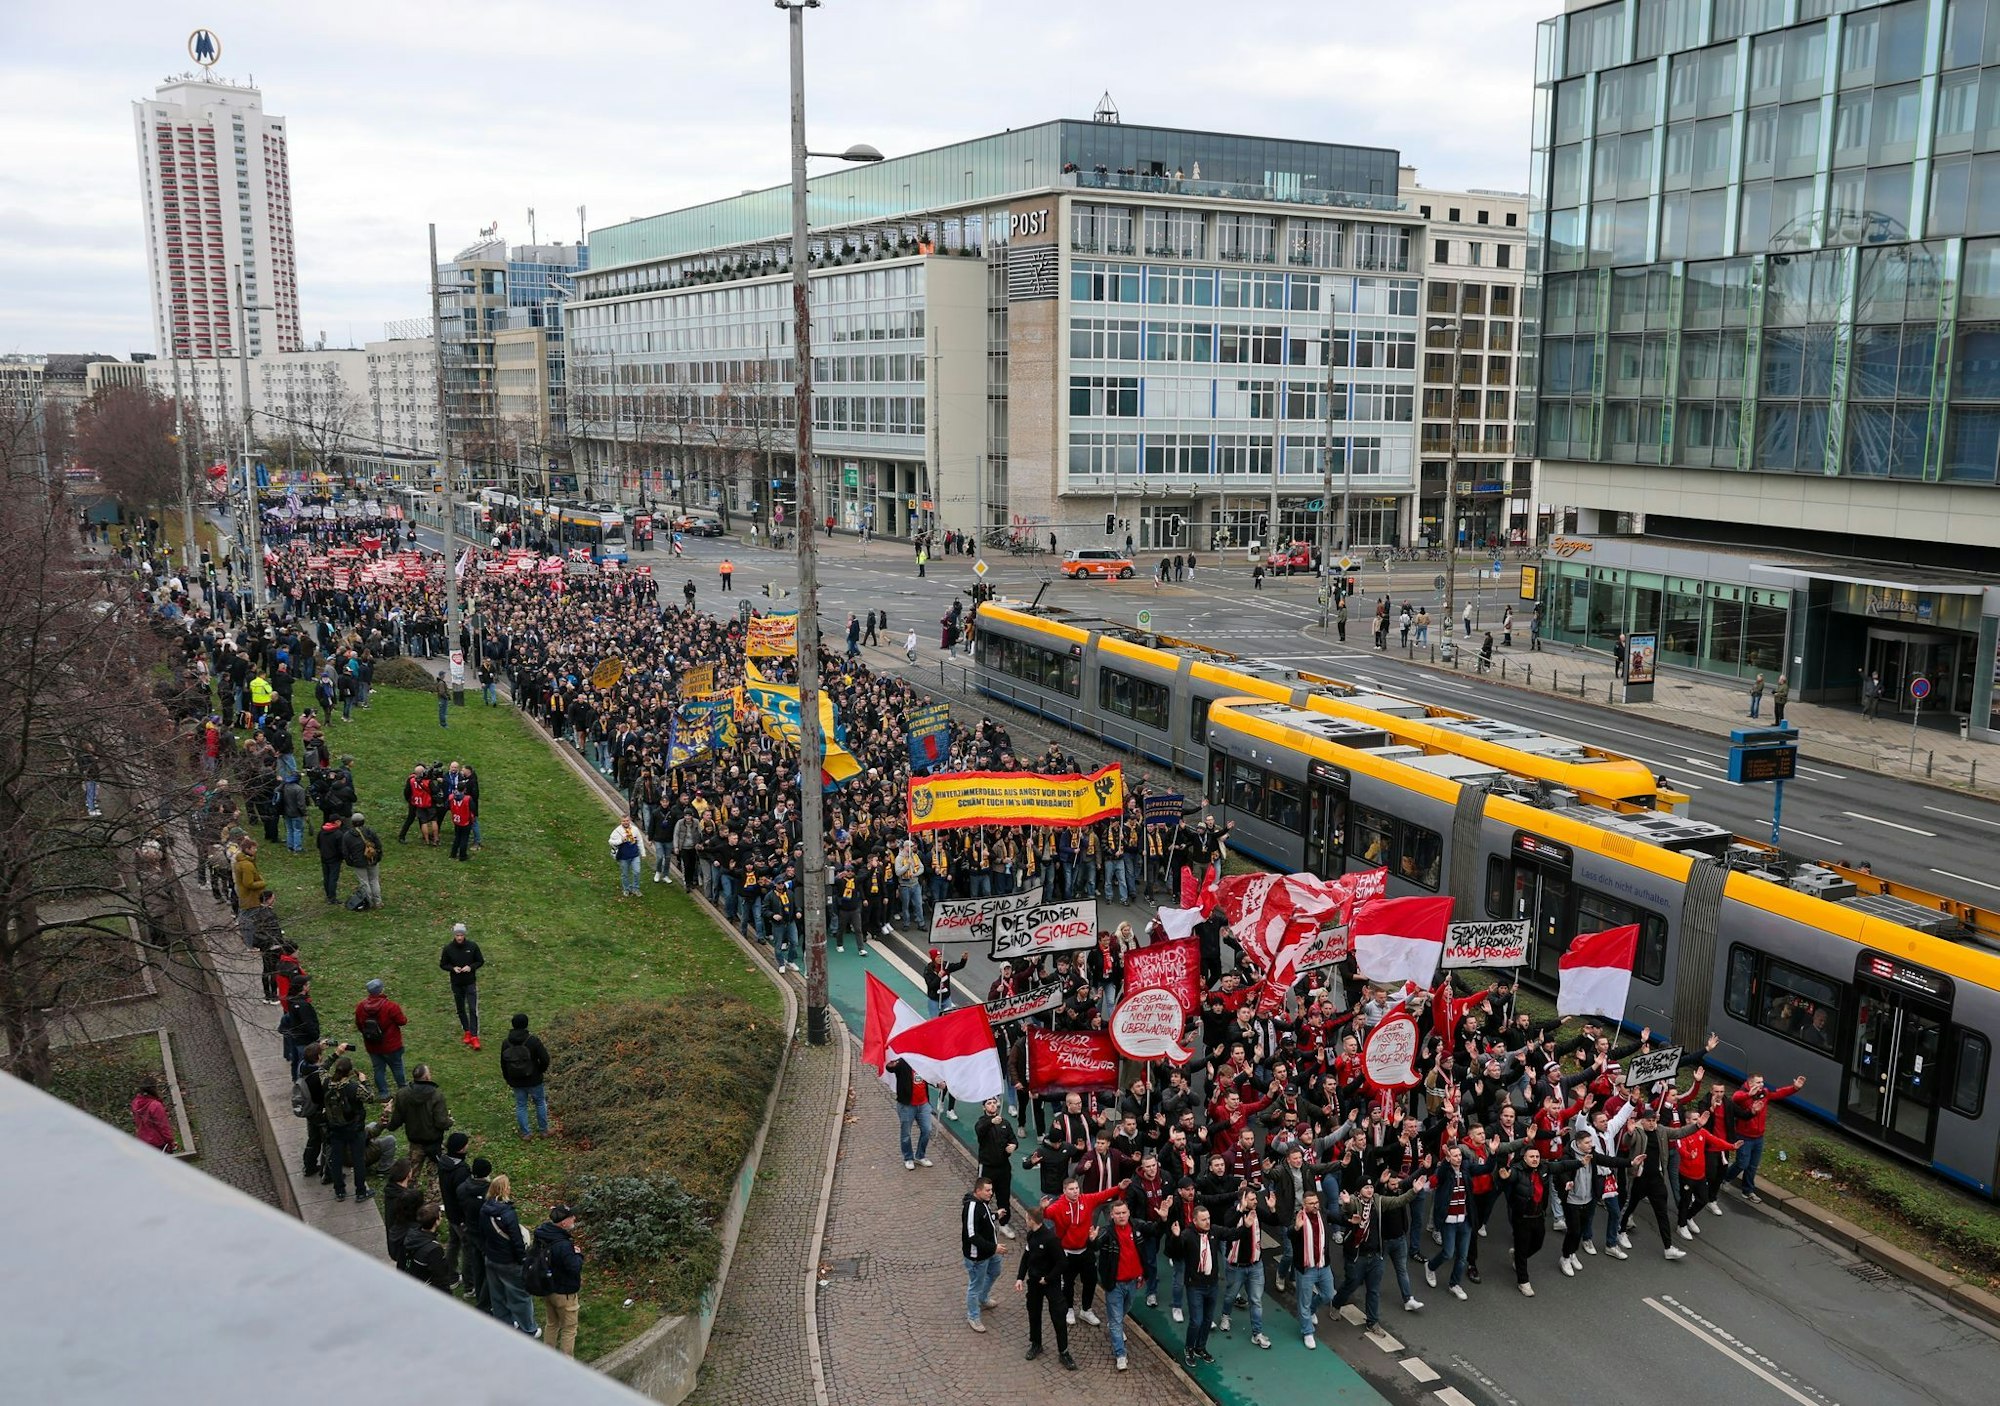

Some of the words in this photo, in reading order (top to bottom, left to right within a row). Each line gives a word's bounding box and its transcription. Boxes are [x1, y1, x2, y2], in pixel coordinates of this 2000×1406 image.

[1011, 209, 1048, 237] POST
[1679, 581, 1775, 606] LOUNGE
[935, 787, 1003, 799] HINTERZIMMERDEALS
[1004, 788, 1018, 797] AUS
[1020, 788, 1040, 796] ANGST
[1042, 788, 1056, 797] VOR
[1058, 789, 1072, 797] UNS
[414, 796, 423, 805] 21
[958, 797, 985, 808] SCHÄMT
[987, 799, 1004, 807] EUCH
[1022, 798, 1035, 806] UND
[1036, 798, 1074, 808] VERBÄNDE!
[453, 814, 461, 823] 23
[1581, 866, 1597, 880] Lass
[1598, 873, 1613, 887] dich
[1614, 881, 1633, 894] nicht
[1634, 888, 1671, 908] aufhalten.
[941, 902, 976, 917] FANS
[1452, 923, 1524, 940] STADIONVERBOTE
[1454, 938, 1472, 948] AUF
[1475, 935, 1523, 948] VERDACHT?
[1446, 946, 1454, 958] IN
[1484, 946, 1501, 959] PRO
[1132, 994, 1169, 1004] FUSSBALL
[986, 1000, 1006, 1013] WEG
[1122, 1004, 1141, 1013] LEBT
[1142, 1004, 1154, 1012] VON
[1129, 1012, 1152, 1021] NICHT
[1157, 1013, 1173, 1023] VON
[1121, 1021, 1177, 1040] ÜBERWACHUNG
[1384, 1023, 1404, 1033] EUER
[1034, 1030, 1091, 1047] WILLKÜR
[1049, 1041, 1100, 1056] STOPPT
[1376, 1043, 1390, 1053] IST
[1394, 1042, 1409, 1054] DAS
[1631, 1048, 1680, 1070] POPULISMUS
